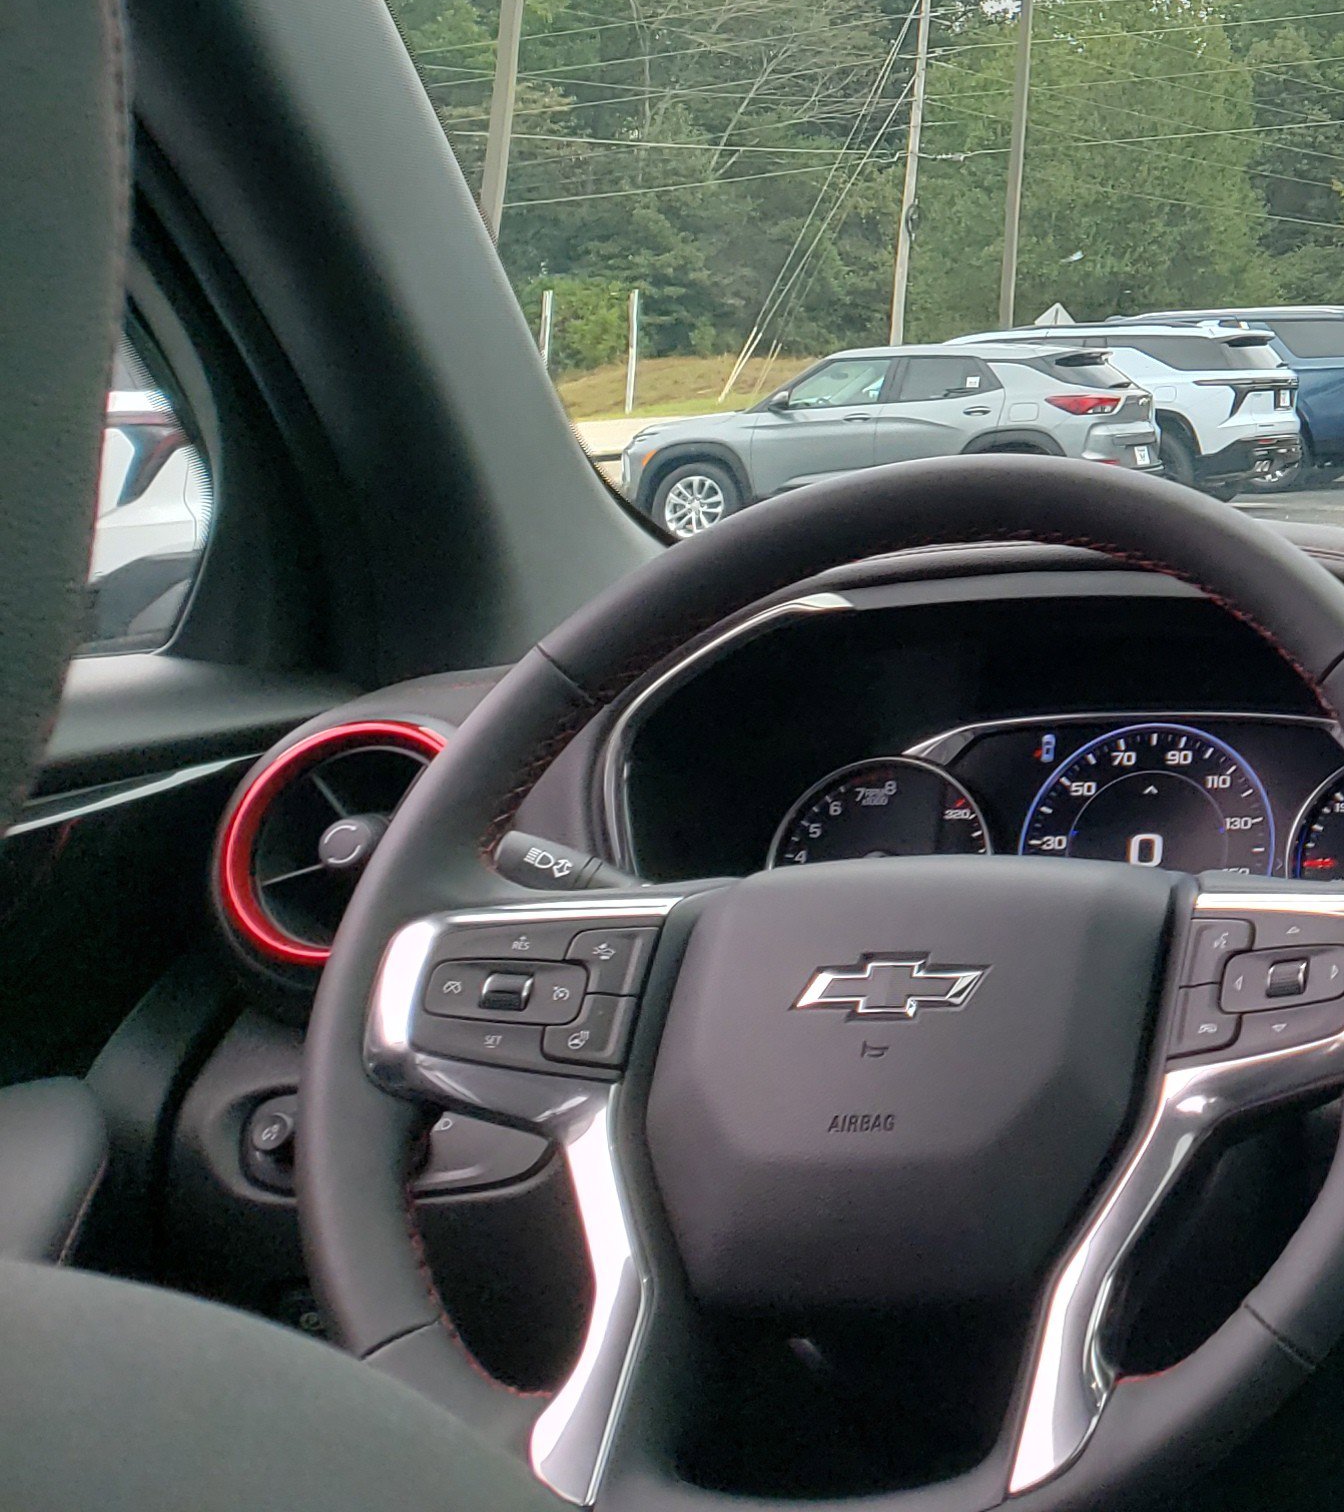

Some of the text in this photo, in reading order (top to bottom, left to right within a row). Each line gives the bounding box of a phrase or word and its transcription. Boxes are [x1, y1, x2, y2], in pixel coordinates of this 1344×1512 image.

[1112, 751, 1136, 766] 70
[1166, 751, 1192, 765] 90
[885, 781, 897, 796] 8
[1206, 775, 1231, 788] 110
[855, 788, 866, 802] 7
[1070, 782, 1096, 796] 50
[829, 801, 842, 816] 6
[1225, 817, 1251, 829] 130
[809, 824, 822, 838] 5
[1042, 836, 1066, 849] 30
[794, 850, 807, 863] 4
[1127, 833, 1163, 867] 0
[512, 941, 529, 950] RES
[485, 1035, 501, 1045] SET
[828, 1114, 895, 1133] AIRBAG
